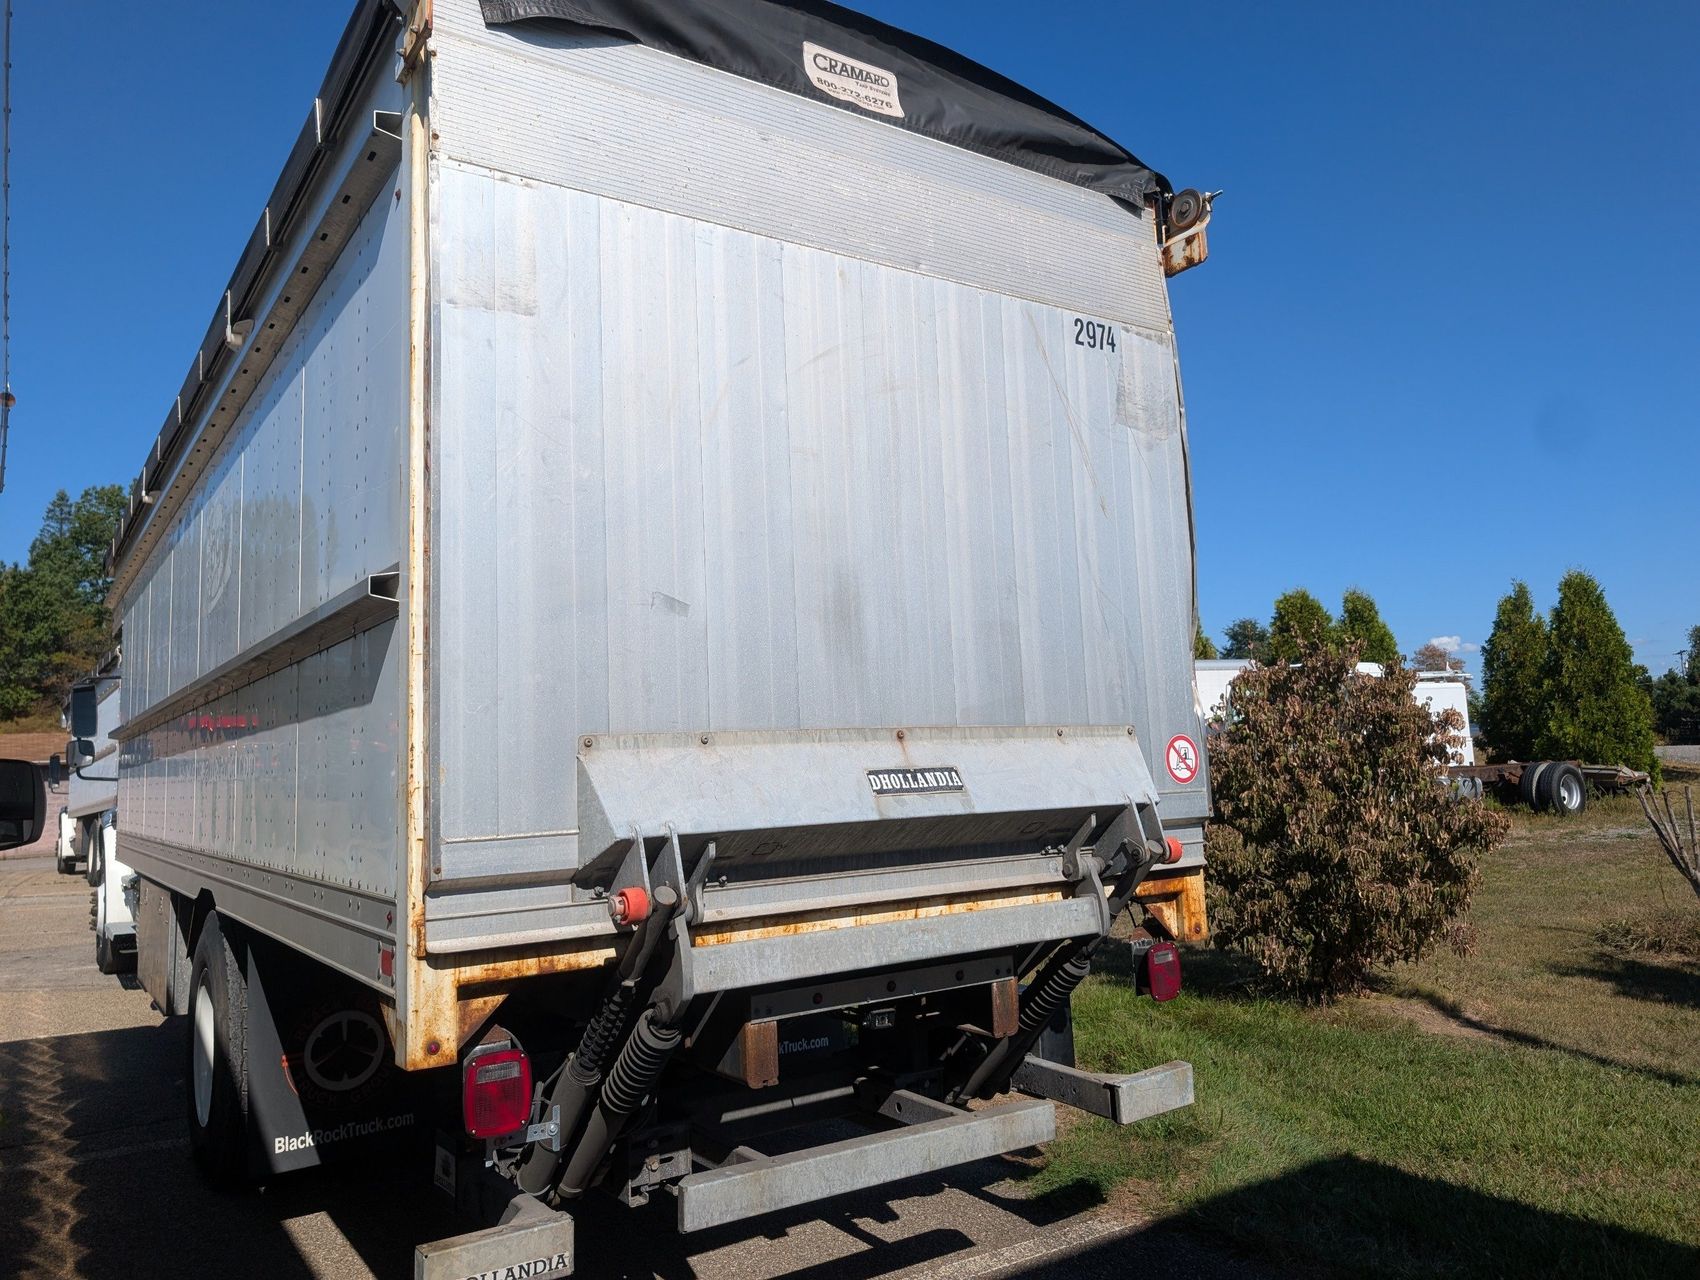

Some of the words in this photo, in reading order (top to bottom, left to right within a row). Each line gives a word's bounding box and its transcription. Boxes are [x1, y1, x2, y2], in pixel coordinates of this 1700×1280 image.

[813, 53, 890, 88] CRAMARO
[816, 76, 893, 109] 800-272-6276
[1074, 318, 1116, 353] 2974
[868, 771, 963, 790] DHOLLANDIA
[274, 1112, 415, 1154] BlackRockTruck.com
